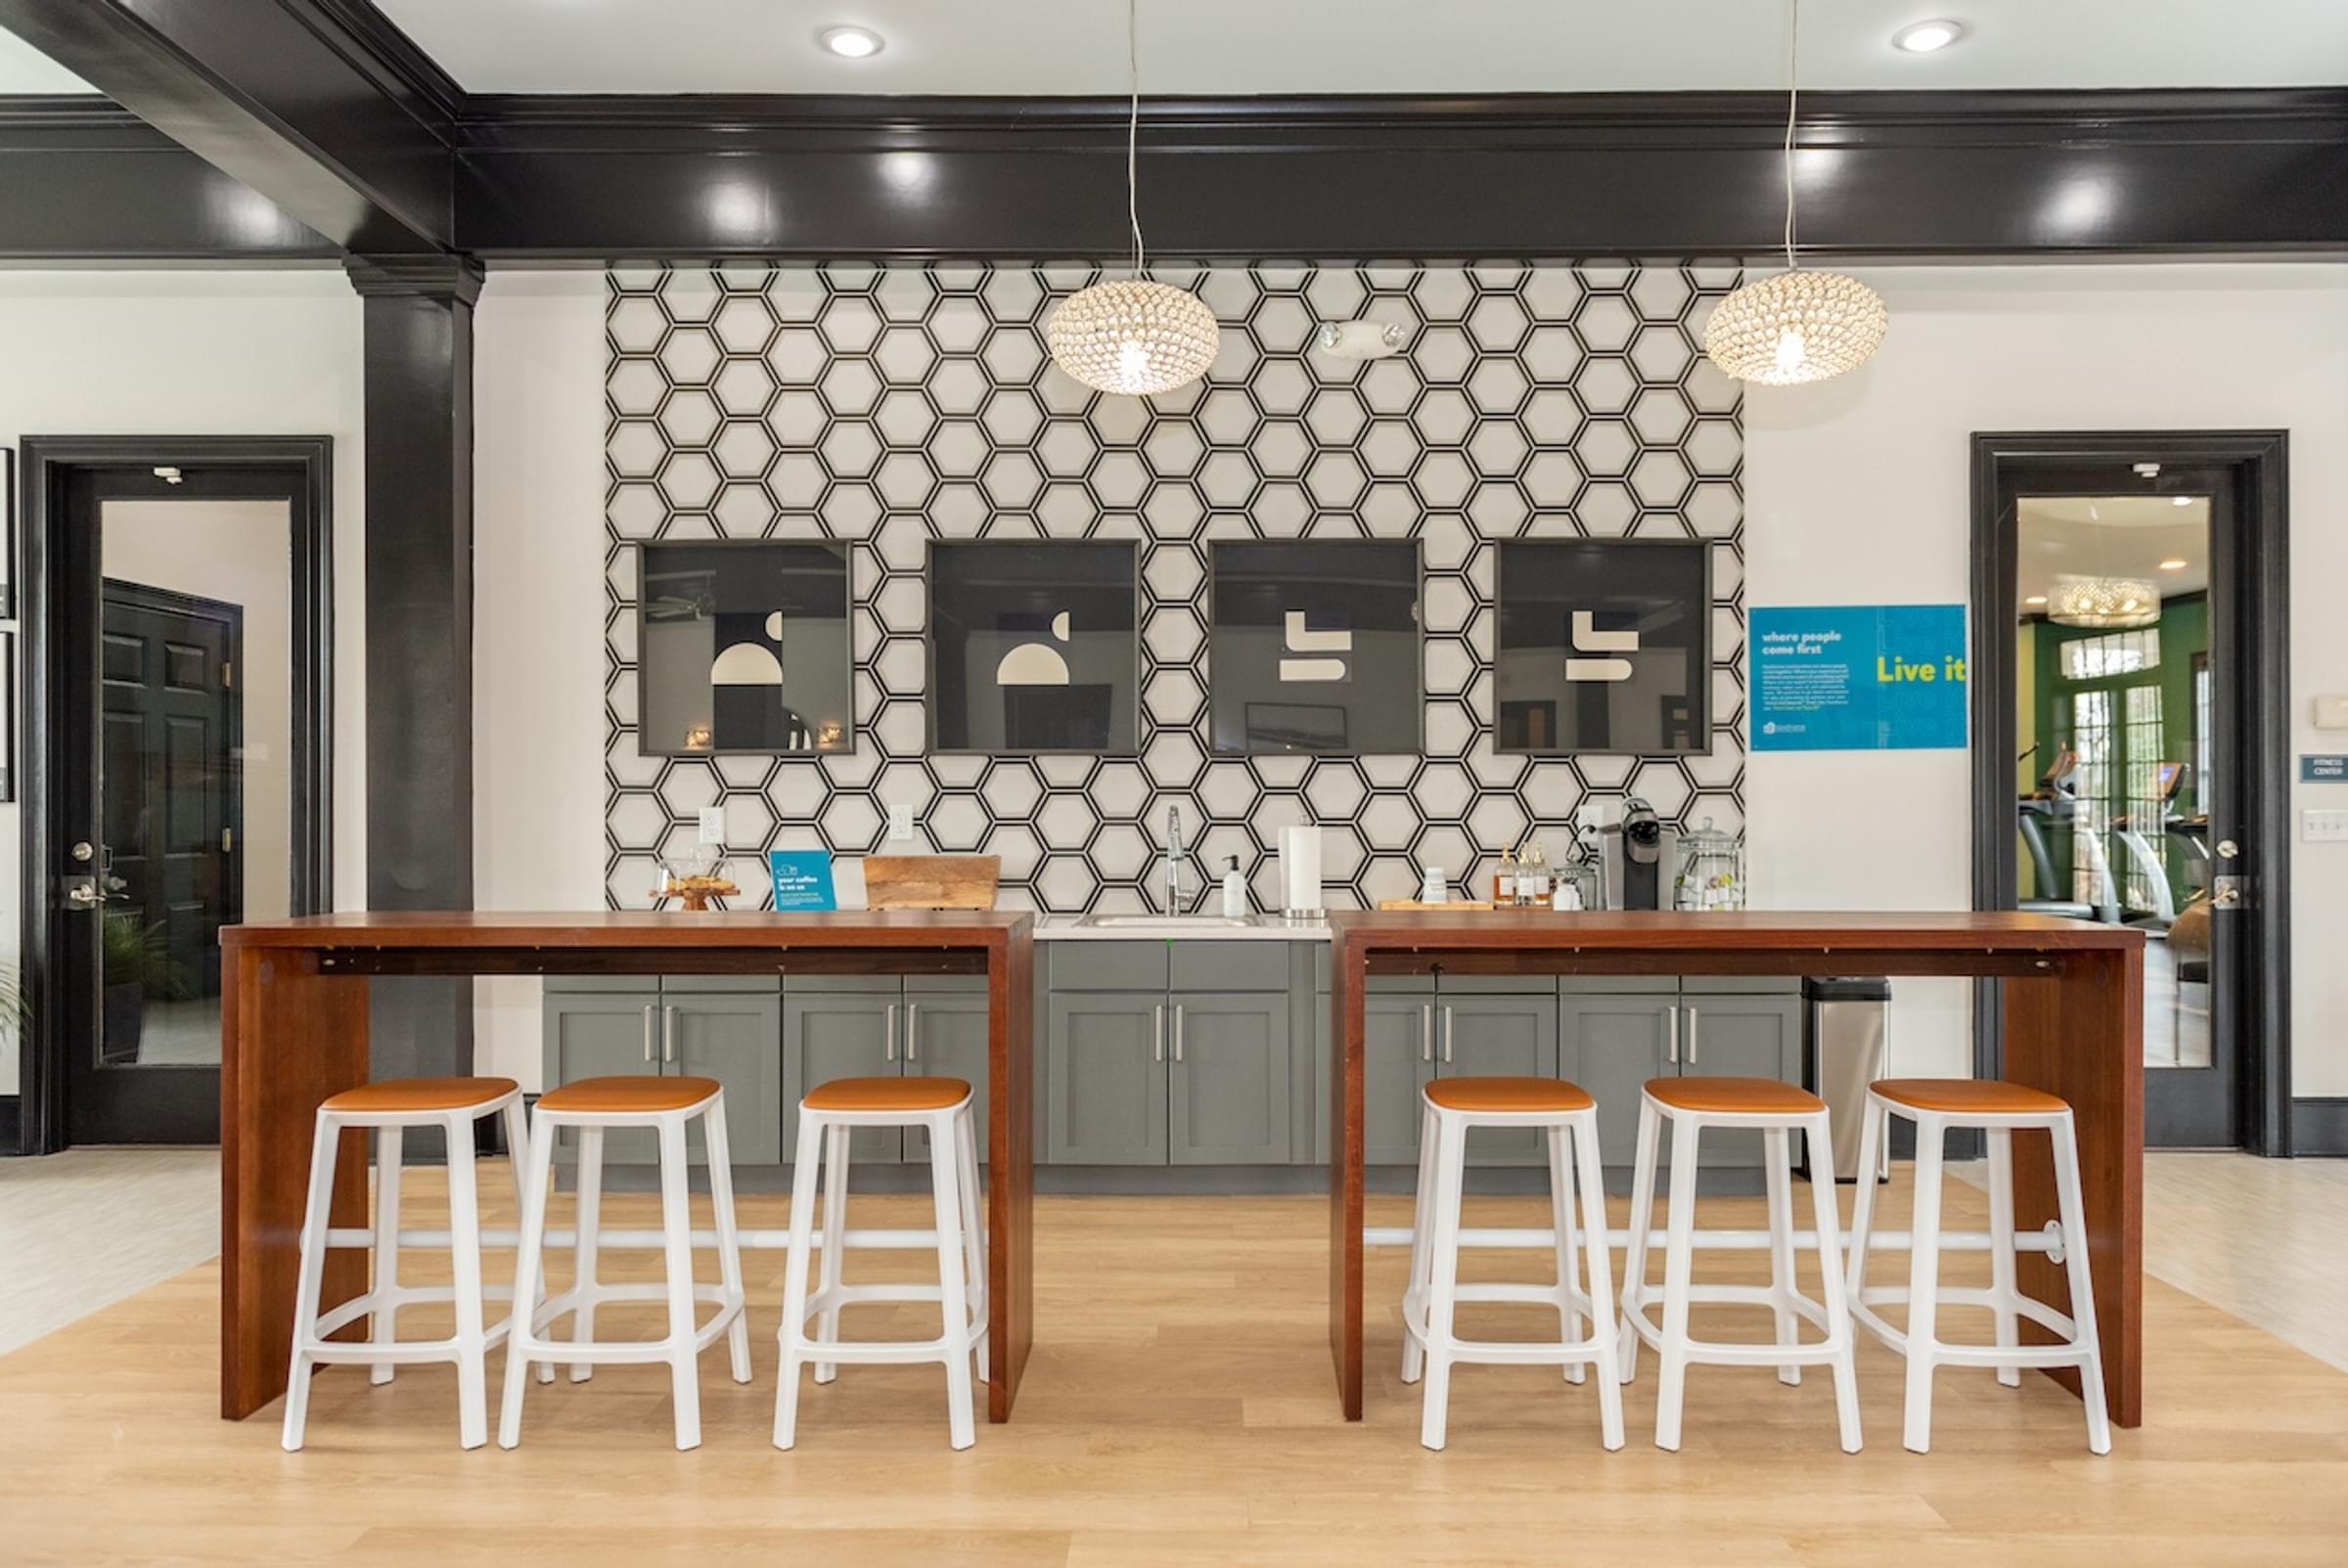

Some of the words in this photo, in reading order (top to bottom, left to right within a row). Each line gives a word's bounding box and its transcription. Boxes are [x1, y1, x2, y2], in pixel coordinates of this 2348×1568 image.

[1762, 631, 1798, 643] where
[1801, 630, 1841, 644] people
[1762, 646, 1794, 655] come
[1796, 643, 1823, 654] first
[1876, 656, 1936, 682] Live
[1944, 654, 1966, 682] it
